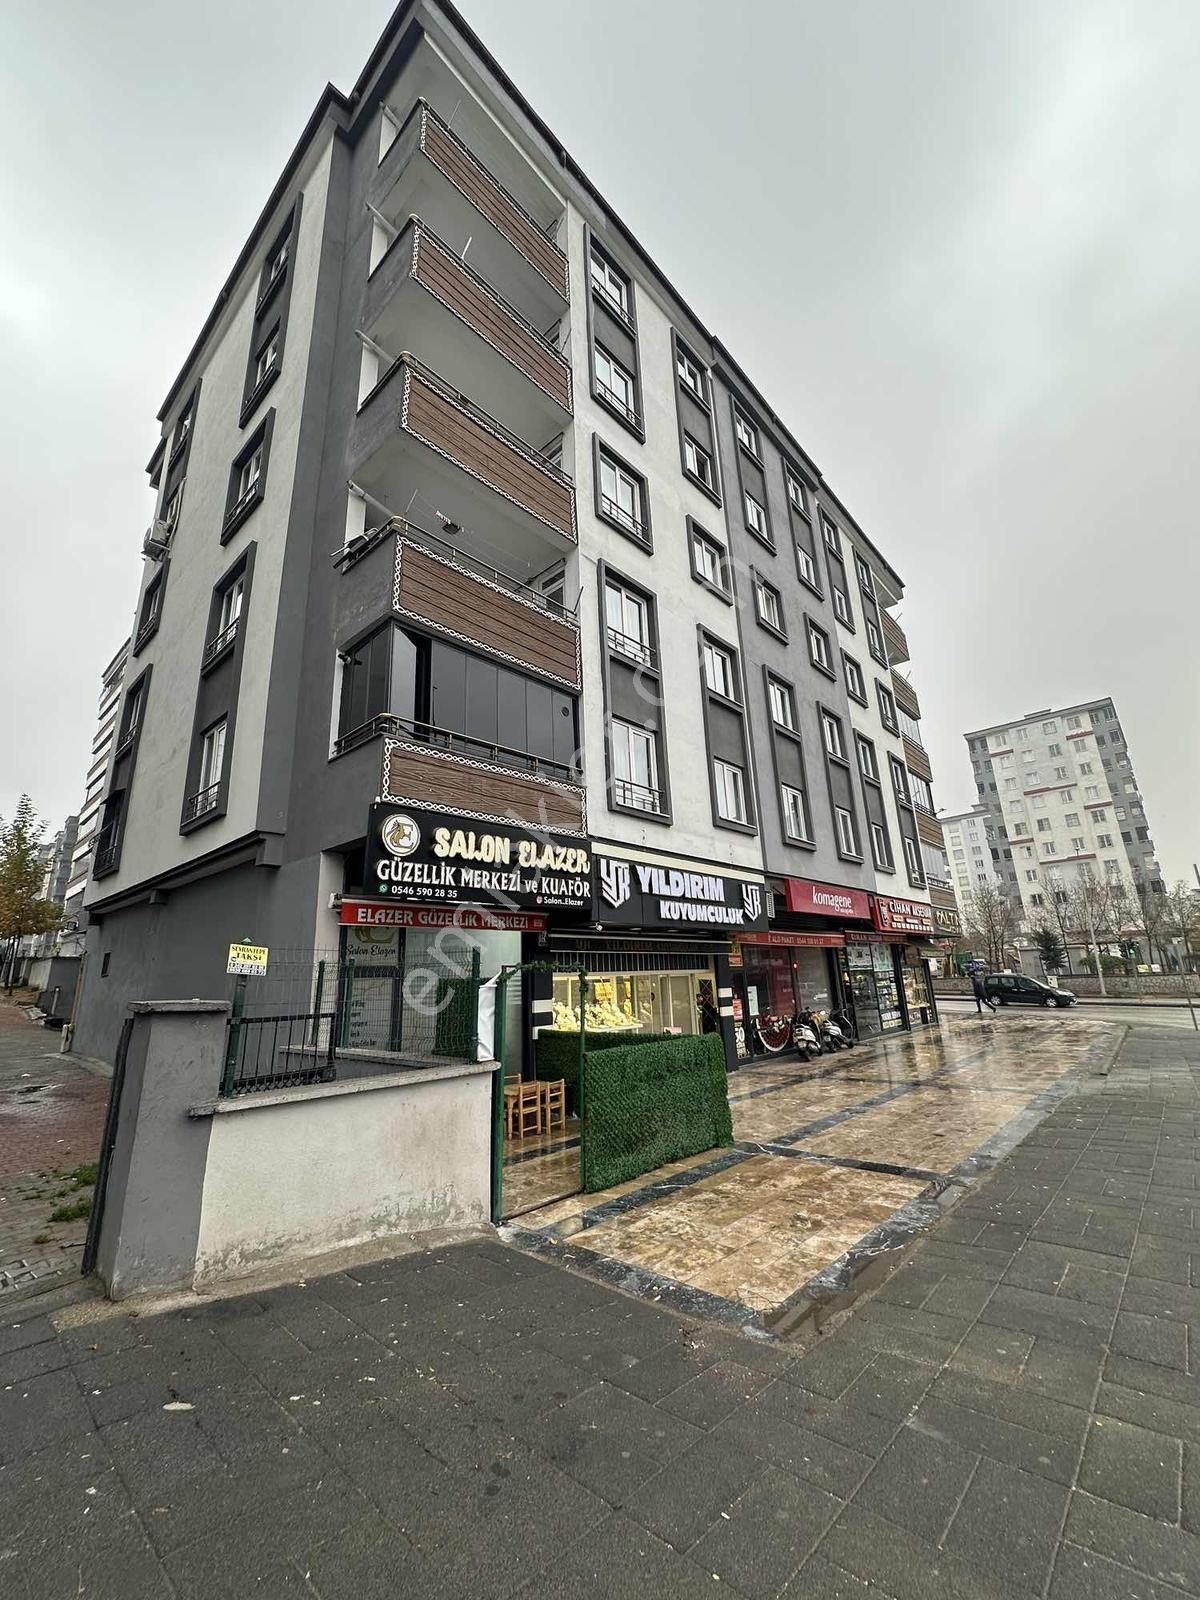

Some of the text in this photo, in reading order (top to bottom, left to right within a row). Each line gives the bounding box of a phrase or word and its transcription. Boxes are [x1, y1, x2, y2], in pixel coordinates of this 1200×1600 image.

[433, 827, 590, 874] SALON ELAZER
[377, 857, 591, 898] GÜZELLİK MERKEZİ ve KUAFÖR
[635, 865, 725, 902] YILDIRIM
[391, 885, 458, 898] 0546 590 28 35
[812, 885, 852, 912] komagene
[357, 908, 414, 925] ELAZER
[418, 908, 478, 927] GÜZELLİK
[481, 915, 529, 930] MERKEZİ
[659, 900, 744, 925] KUYUMCULUK
